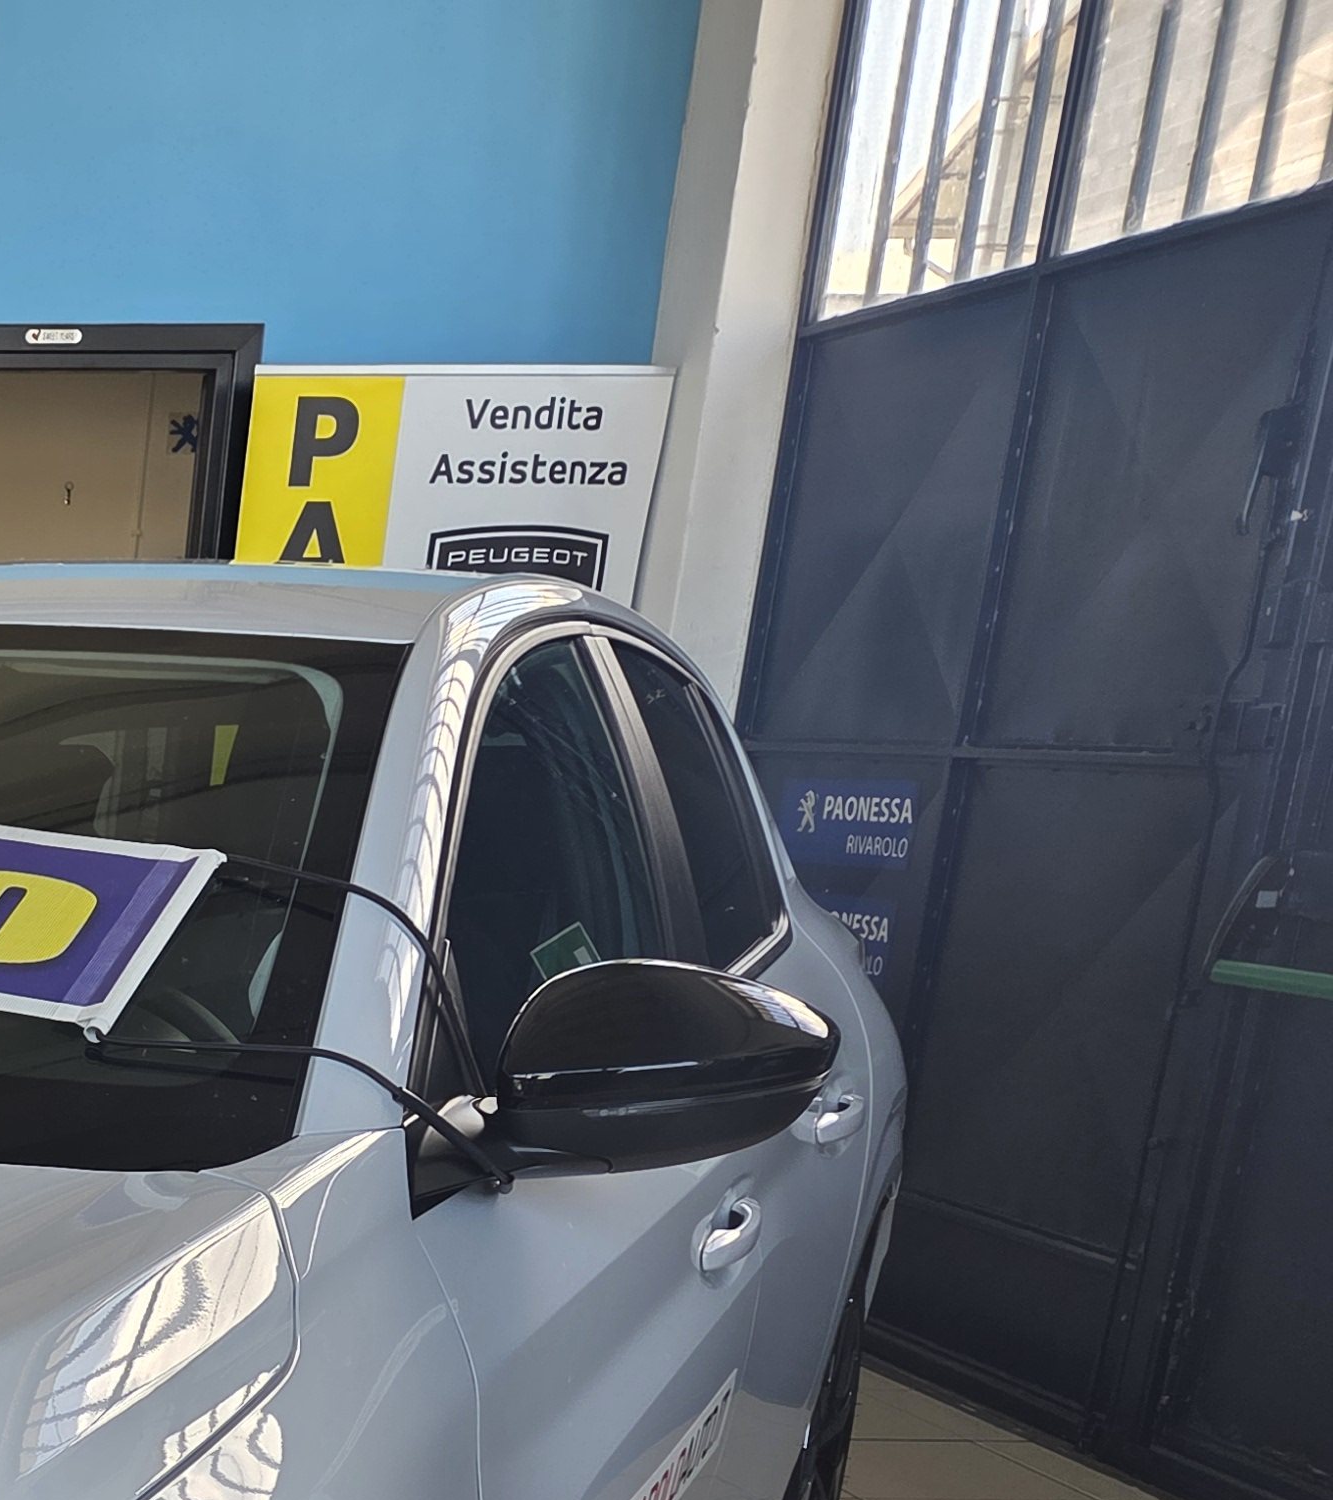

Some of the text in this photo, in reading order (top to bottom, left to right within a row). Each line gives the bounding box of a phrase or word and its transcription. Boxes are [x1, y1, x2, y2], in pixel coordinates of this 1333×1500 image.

[466, 396, 603, 430] Vendita
[429, 451, 628, 486] Assistenza
[446, 546, 589, 568] PEUGEOT
[822, 795, 913, 824] PAONESSA
[846, 834, 909, 859] RIVAROLO
